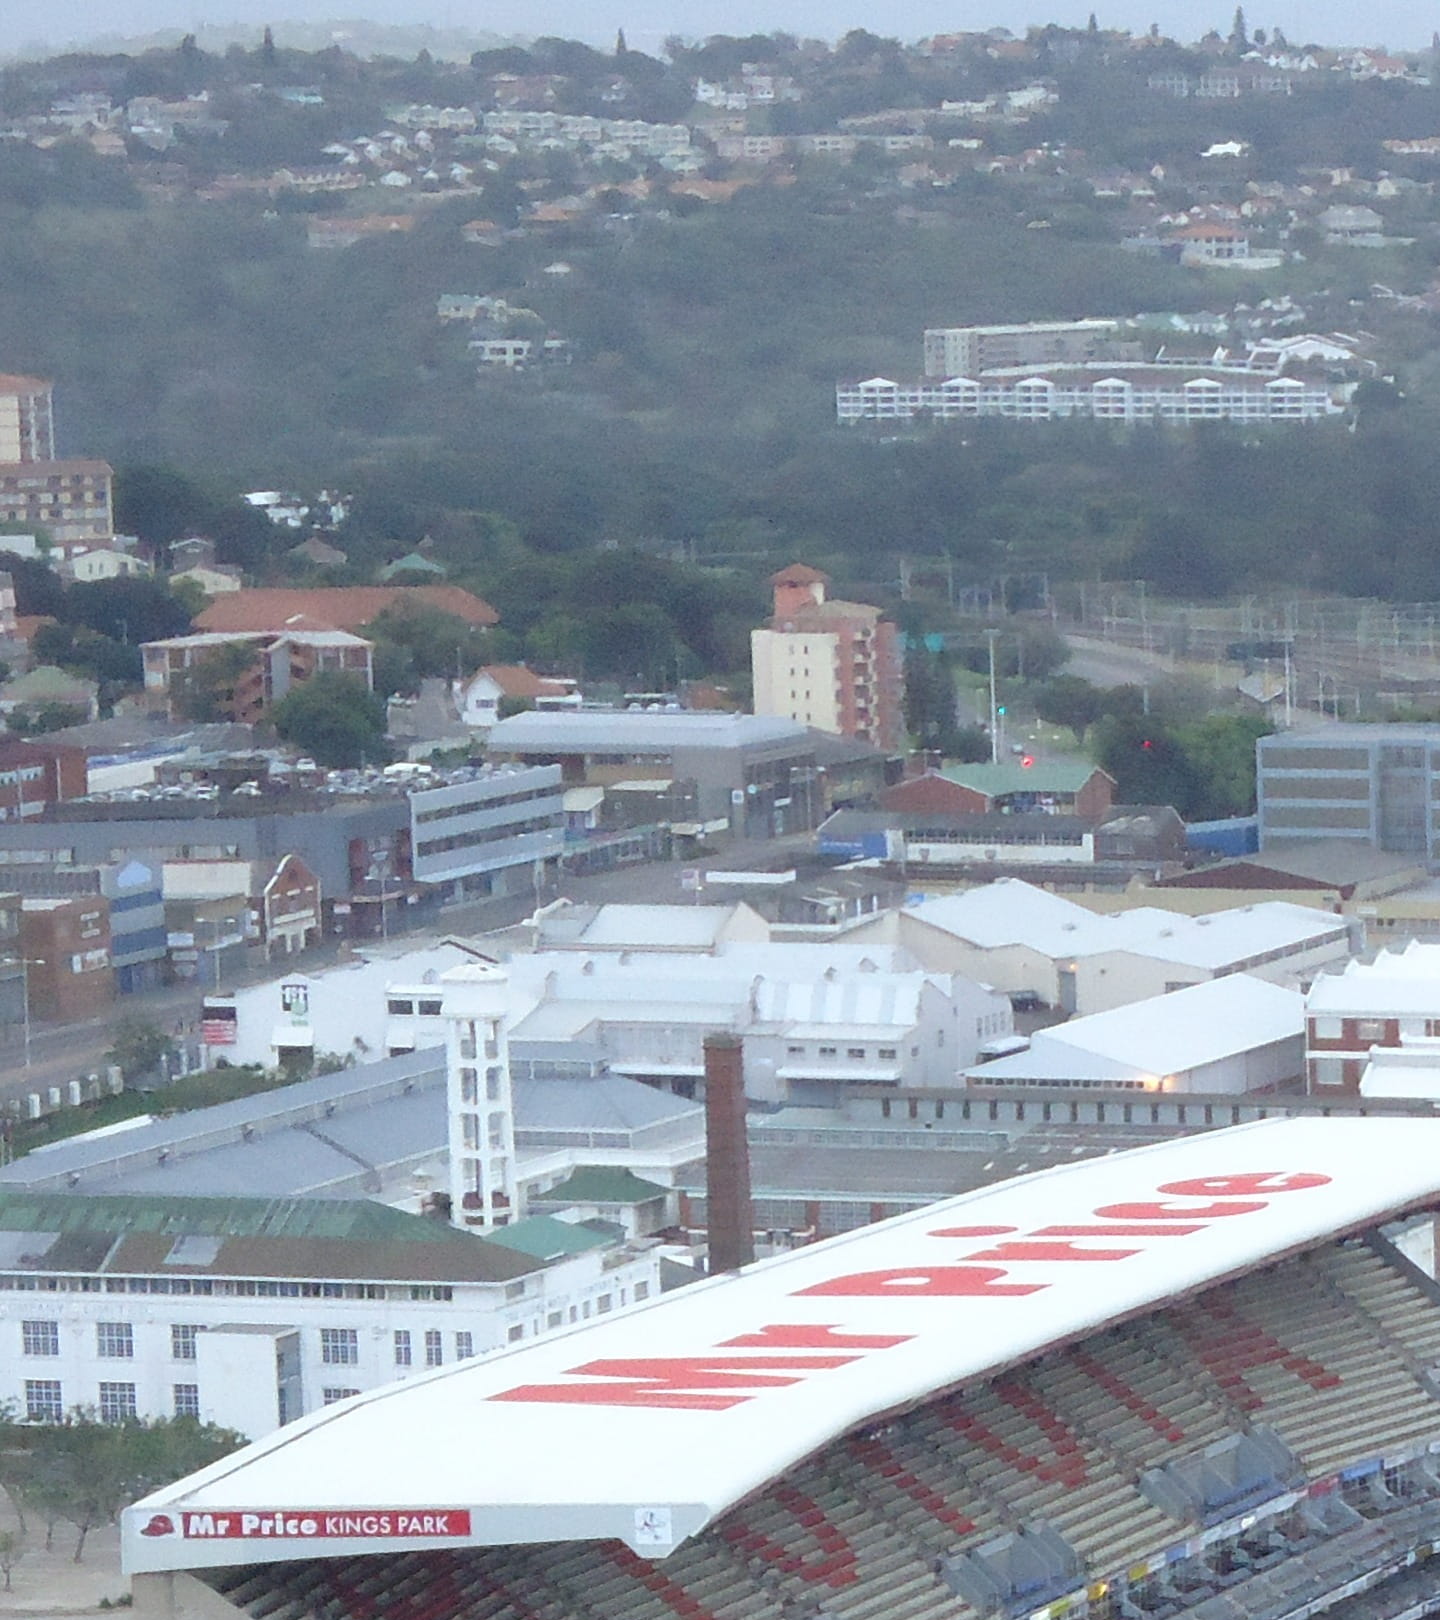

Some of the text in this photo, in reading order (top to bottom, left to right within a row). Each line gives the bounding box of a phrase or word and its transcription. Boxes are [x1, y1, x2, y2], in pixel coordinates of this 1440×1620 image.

[485, 1171, 1333, 1411] Mr Price
[189, 1512, 449, 1535] Mr Price KINGS PARK
